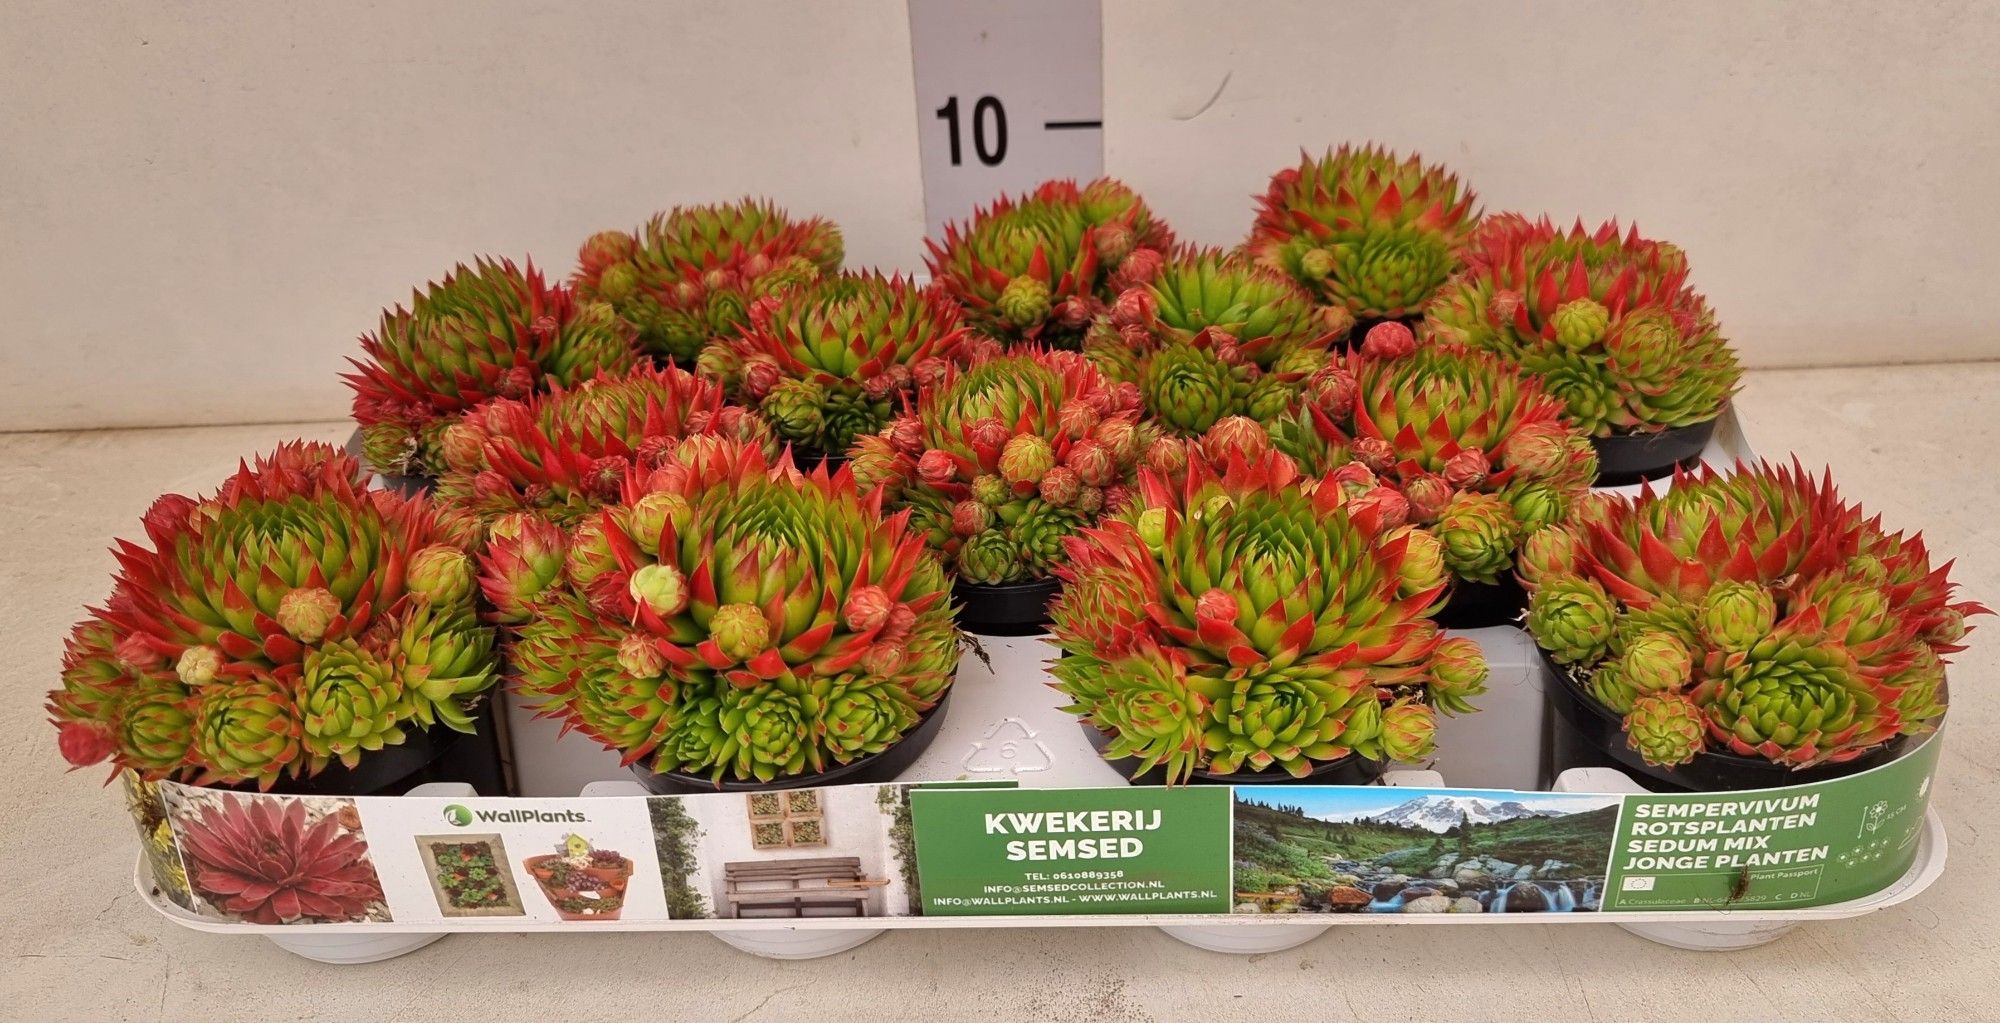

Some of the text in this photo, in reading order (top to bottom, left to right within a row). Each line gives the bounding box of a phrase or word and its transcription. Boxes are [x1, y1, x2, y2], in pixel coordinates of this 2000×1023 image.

[936, 96, 1008, 167] 10
[475, 809, 586, 823] WallPlants
[1634, 793, 1820, 818] SEMPERVIVUM
[985, 809, 1162, 834] KWEKERIJ
[1631, 812, 1817, 836] ROTSPLANTEN
[1006, 837, 1144, 861] SEMSED
[1627, 835, 1771, 853] SEDUM MIX
[1623, 845, 1829, 870] JONGE PLANTEN
[1024, 870, 1124, 881] TEL: 0610889358
[1777, 869, 1818, 878] Passport
[983, 880, 1165, 894] INFO@SEMSEDCOLLECTION.NL
[933, 895, 1070, 906] INFO@WALLPLANTS.NL
[1079, 890, 1217, 902] WWW.WALLPLANTS.NL
